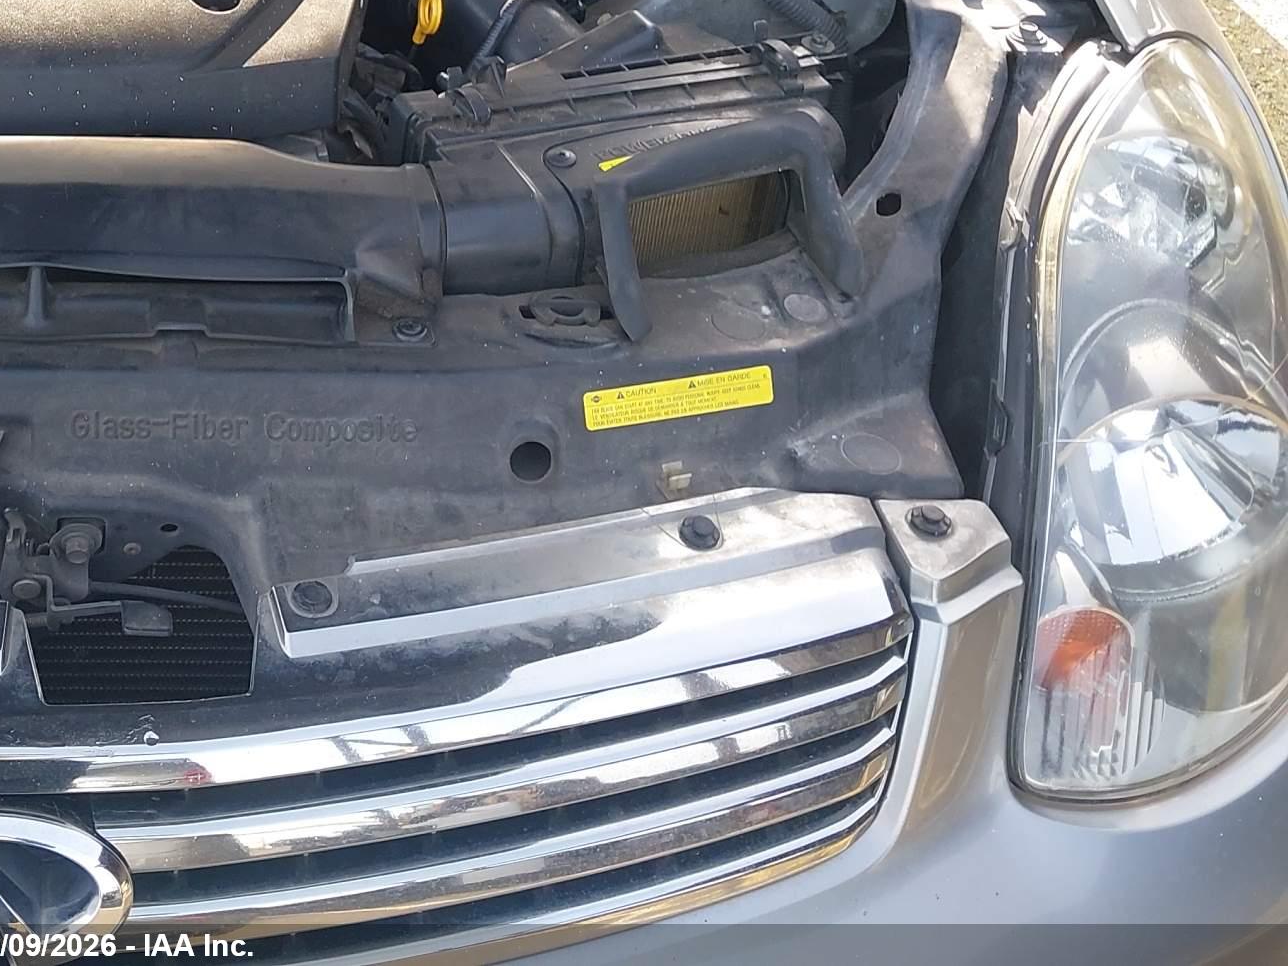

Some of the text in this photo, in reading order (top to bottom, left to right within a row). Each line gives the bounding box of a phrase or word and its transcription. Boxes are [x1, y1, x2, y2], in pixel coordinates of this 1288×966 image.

[715, 375, 725, 383] EN
[727, 371, 751, 381] GARDE
[625, 386, 656, 397] CAUTION
[68, 409, 420, 447] Glass-Fiber Composite
